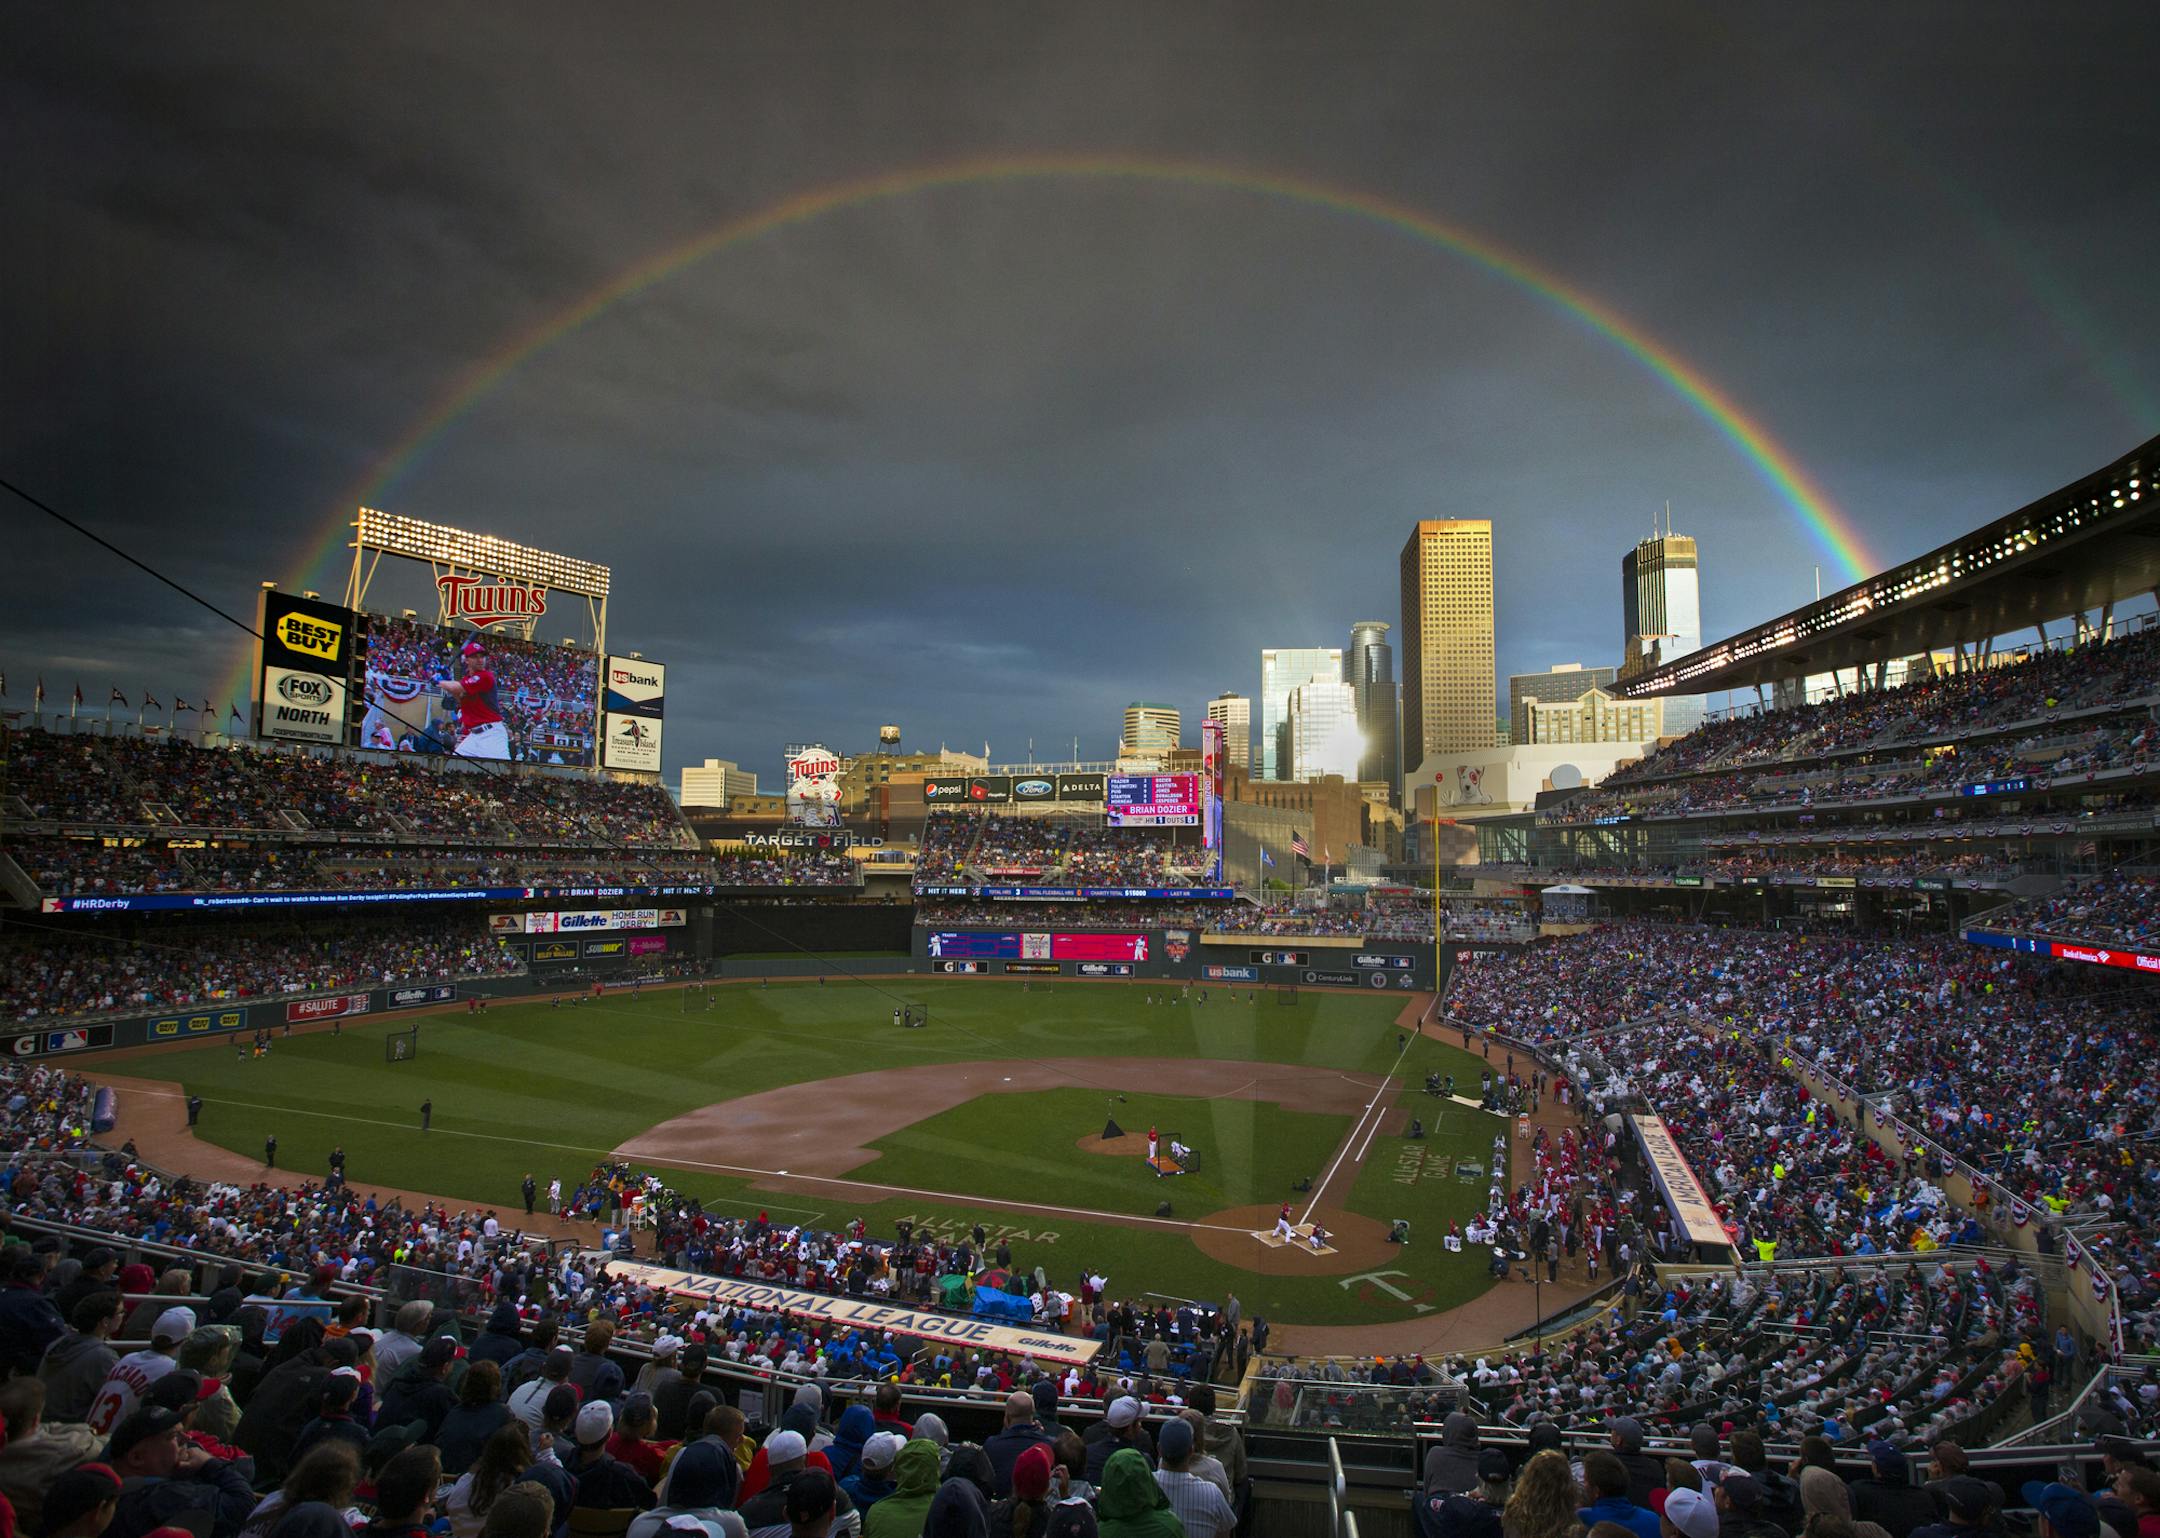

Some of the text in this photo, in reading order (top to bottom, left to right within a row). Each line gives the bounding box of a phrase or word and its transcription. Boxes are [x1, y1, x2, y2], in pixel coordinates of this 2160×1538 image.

[436, 575, 547, 619] Twins
[286, 618, 339, 641] BEST
[286, 631, 336, 652] BUY
[290, 680, 320, 695] FOX
[290, 692, 321, 701] SPORTS
[277, 706, 330, 726] NORTH
[272, 728, 334, 740] FOXSPORTSNORTH.COM
[612, 736, 656, 748] Treasure Island
[790, 758, 838, 780] Twins
[938, 784, 961, 795] pepsi
[1022, 785, 1044, 794] Ford
[745, 835, 884, 846] TARGET FIELD
[72, 899, 130, 909] #HRDerby
[561, 915, 607, 928] Gillette
[586, 943, 623, 954] SUBWAY
[1262, 953, 1272, 963] G
[1357, 956, 1385, 965] Gillette
[2137, 956, 2157, 968] Official
[944, 962, 954, 972] G
[1209, 967, 1250, 978] usbank
[1318, 974, 1353, 983] CenturyLink
[395, 990, 426, 1001] Gillette
[299, 1000, 338, 1014] #SALUTE
[14, 1034, 35, 1055] G
[1645, 1134, 1707, 1207] AMERICAN LEAGUE
[672, 1275, 994, 1341] NATIONAL LEAGUE
[1017, 1336, 1077, 1352] Gillette
